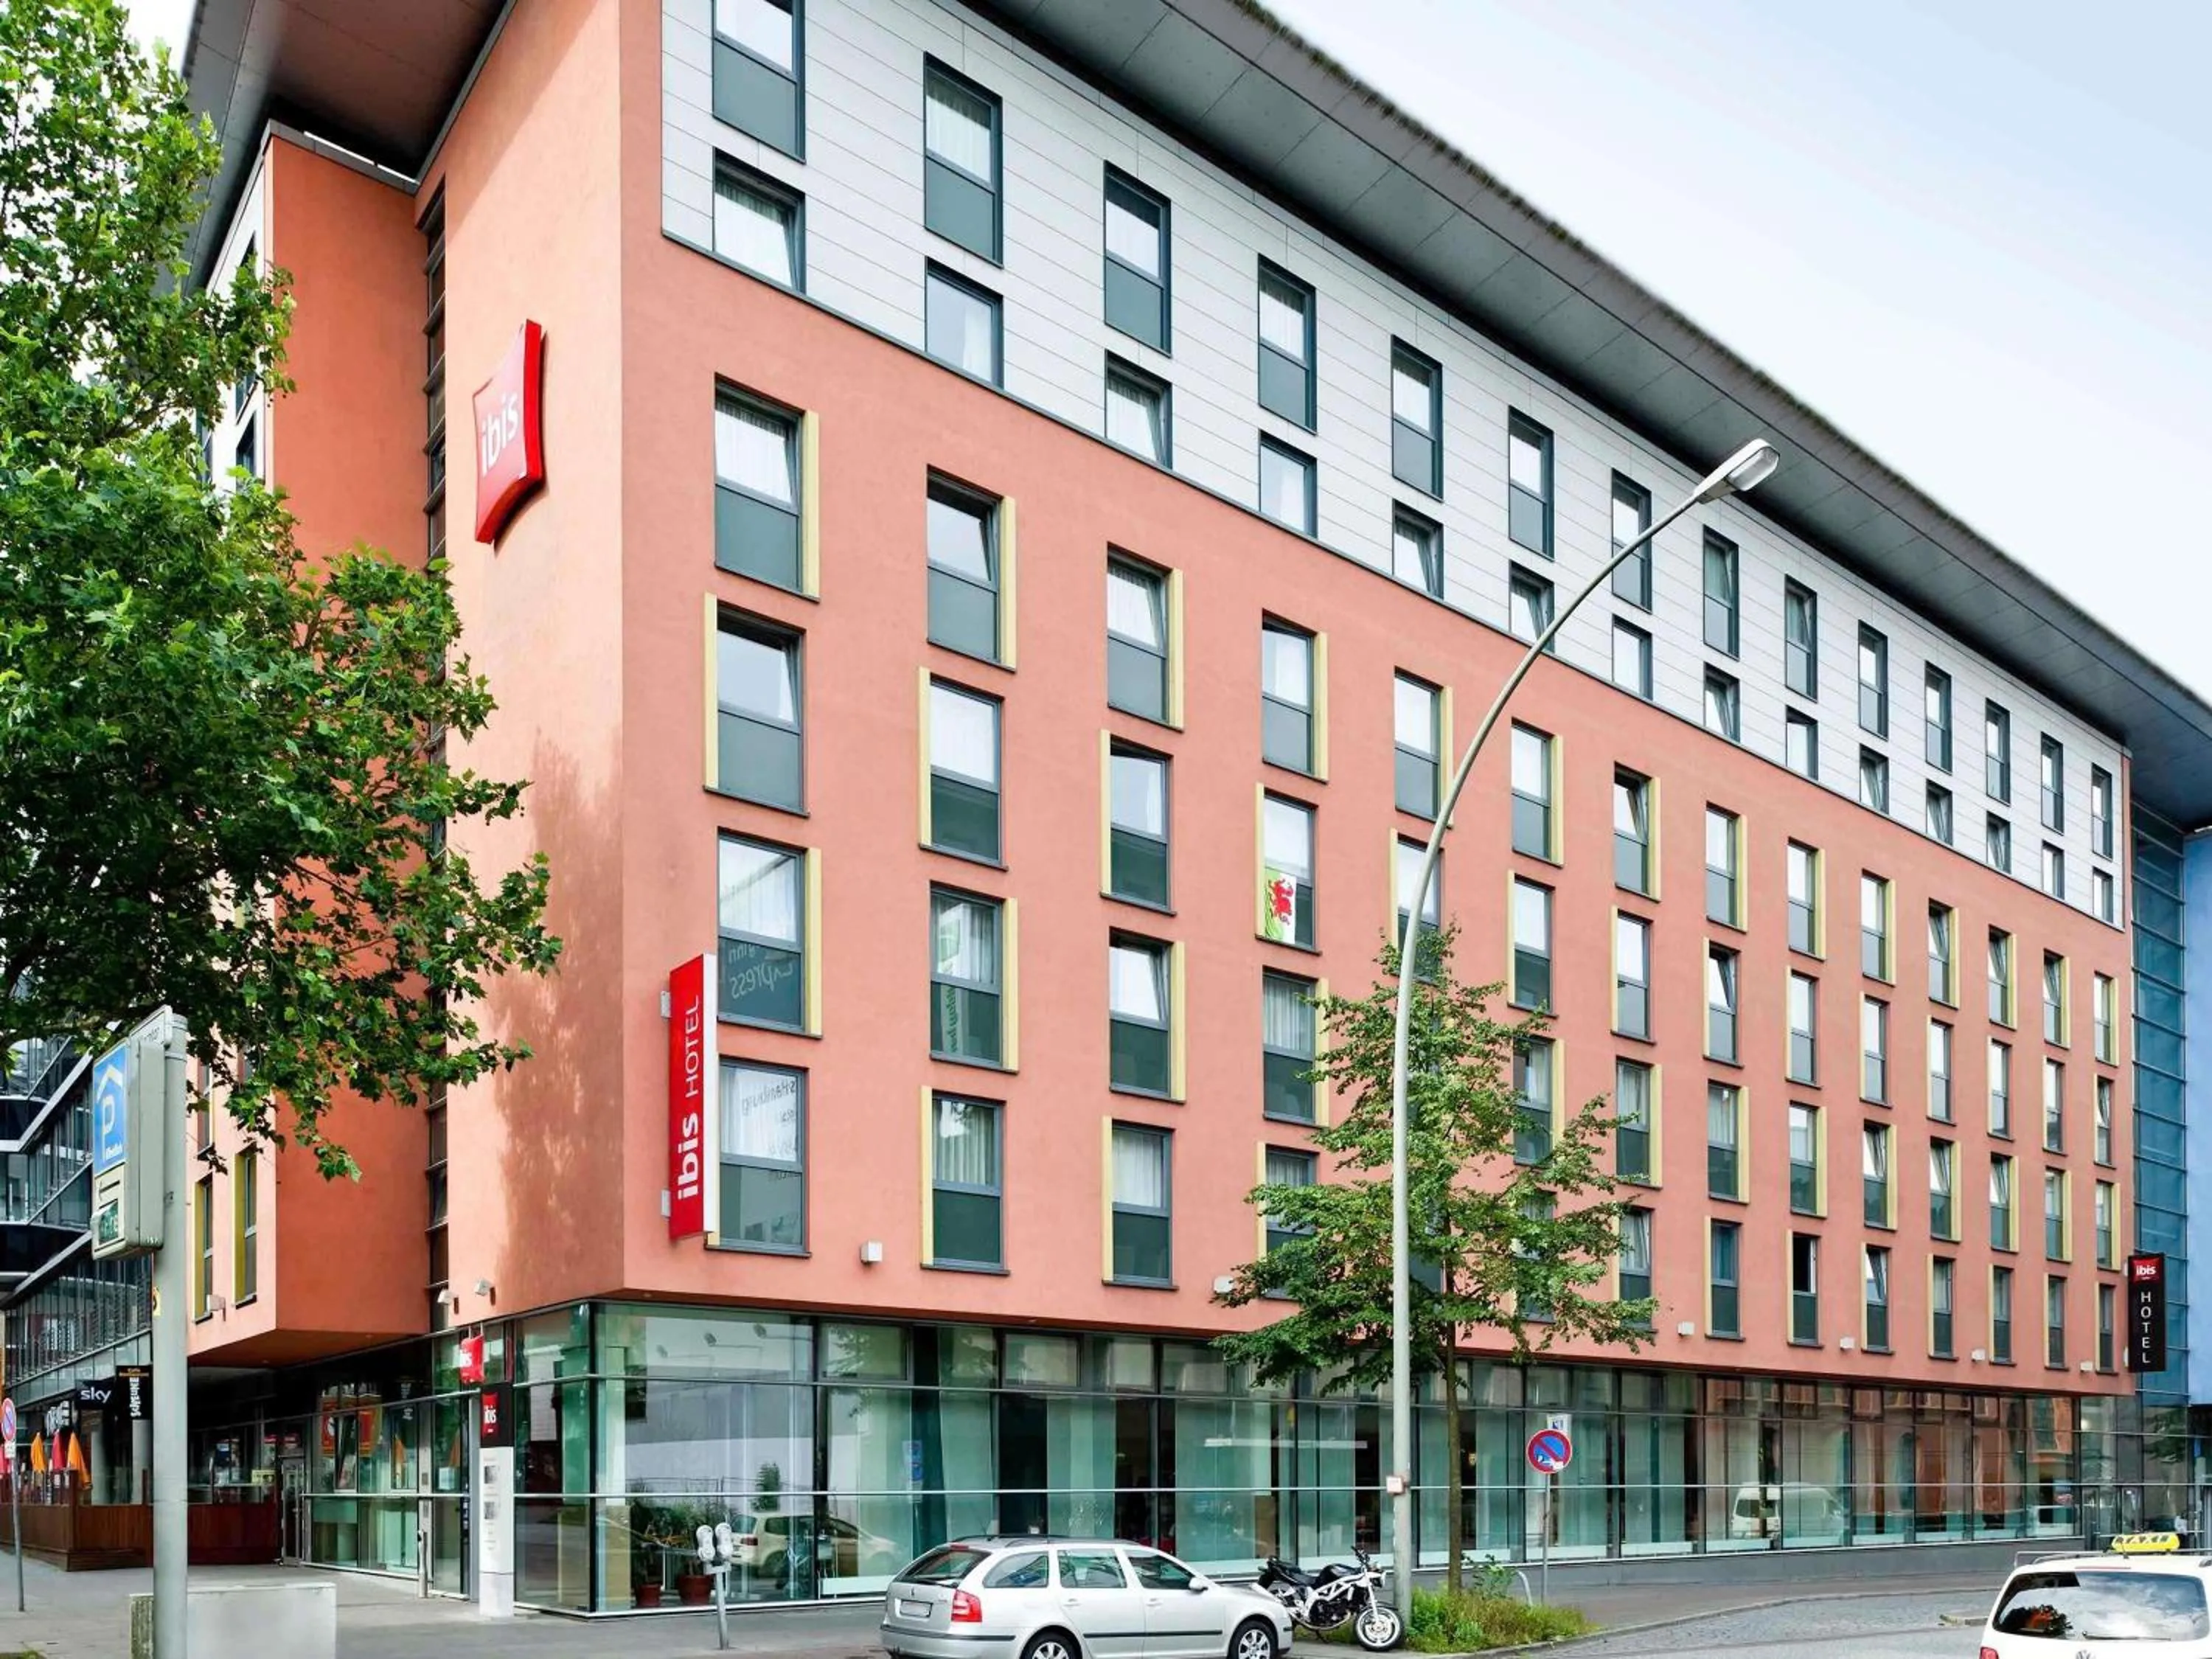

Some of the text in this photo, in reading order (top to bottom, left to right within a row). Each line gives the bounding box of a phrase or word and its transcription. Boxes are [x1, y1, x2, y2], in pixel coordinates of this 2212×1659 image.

[481, 393, 519, 478] ibis
[102, 1093, 115, 1161] P
[678, 994, 700, 1201] ibis HOTEL
[2135, 1265, 2157, 1276] ibis
[2140, 1291, 2152, 1363] HOTEL
[80, 1387, 111, 1403] sky
